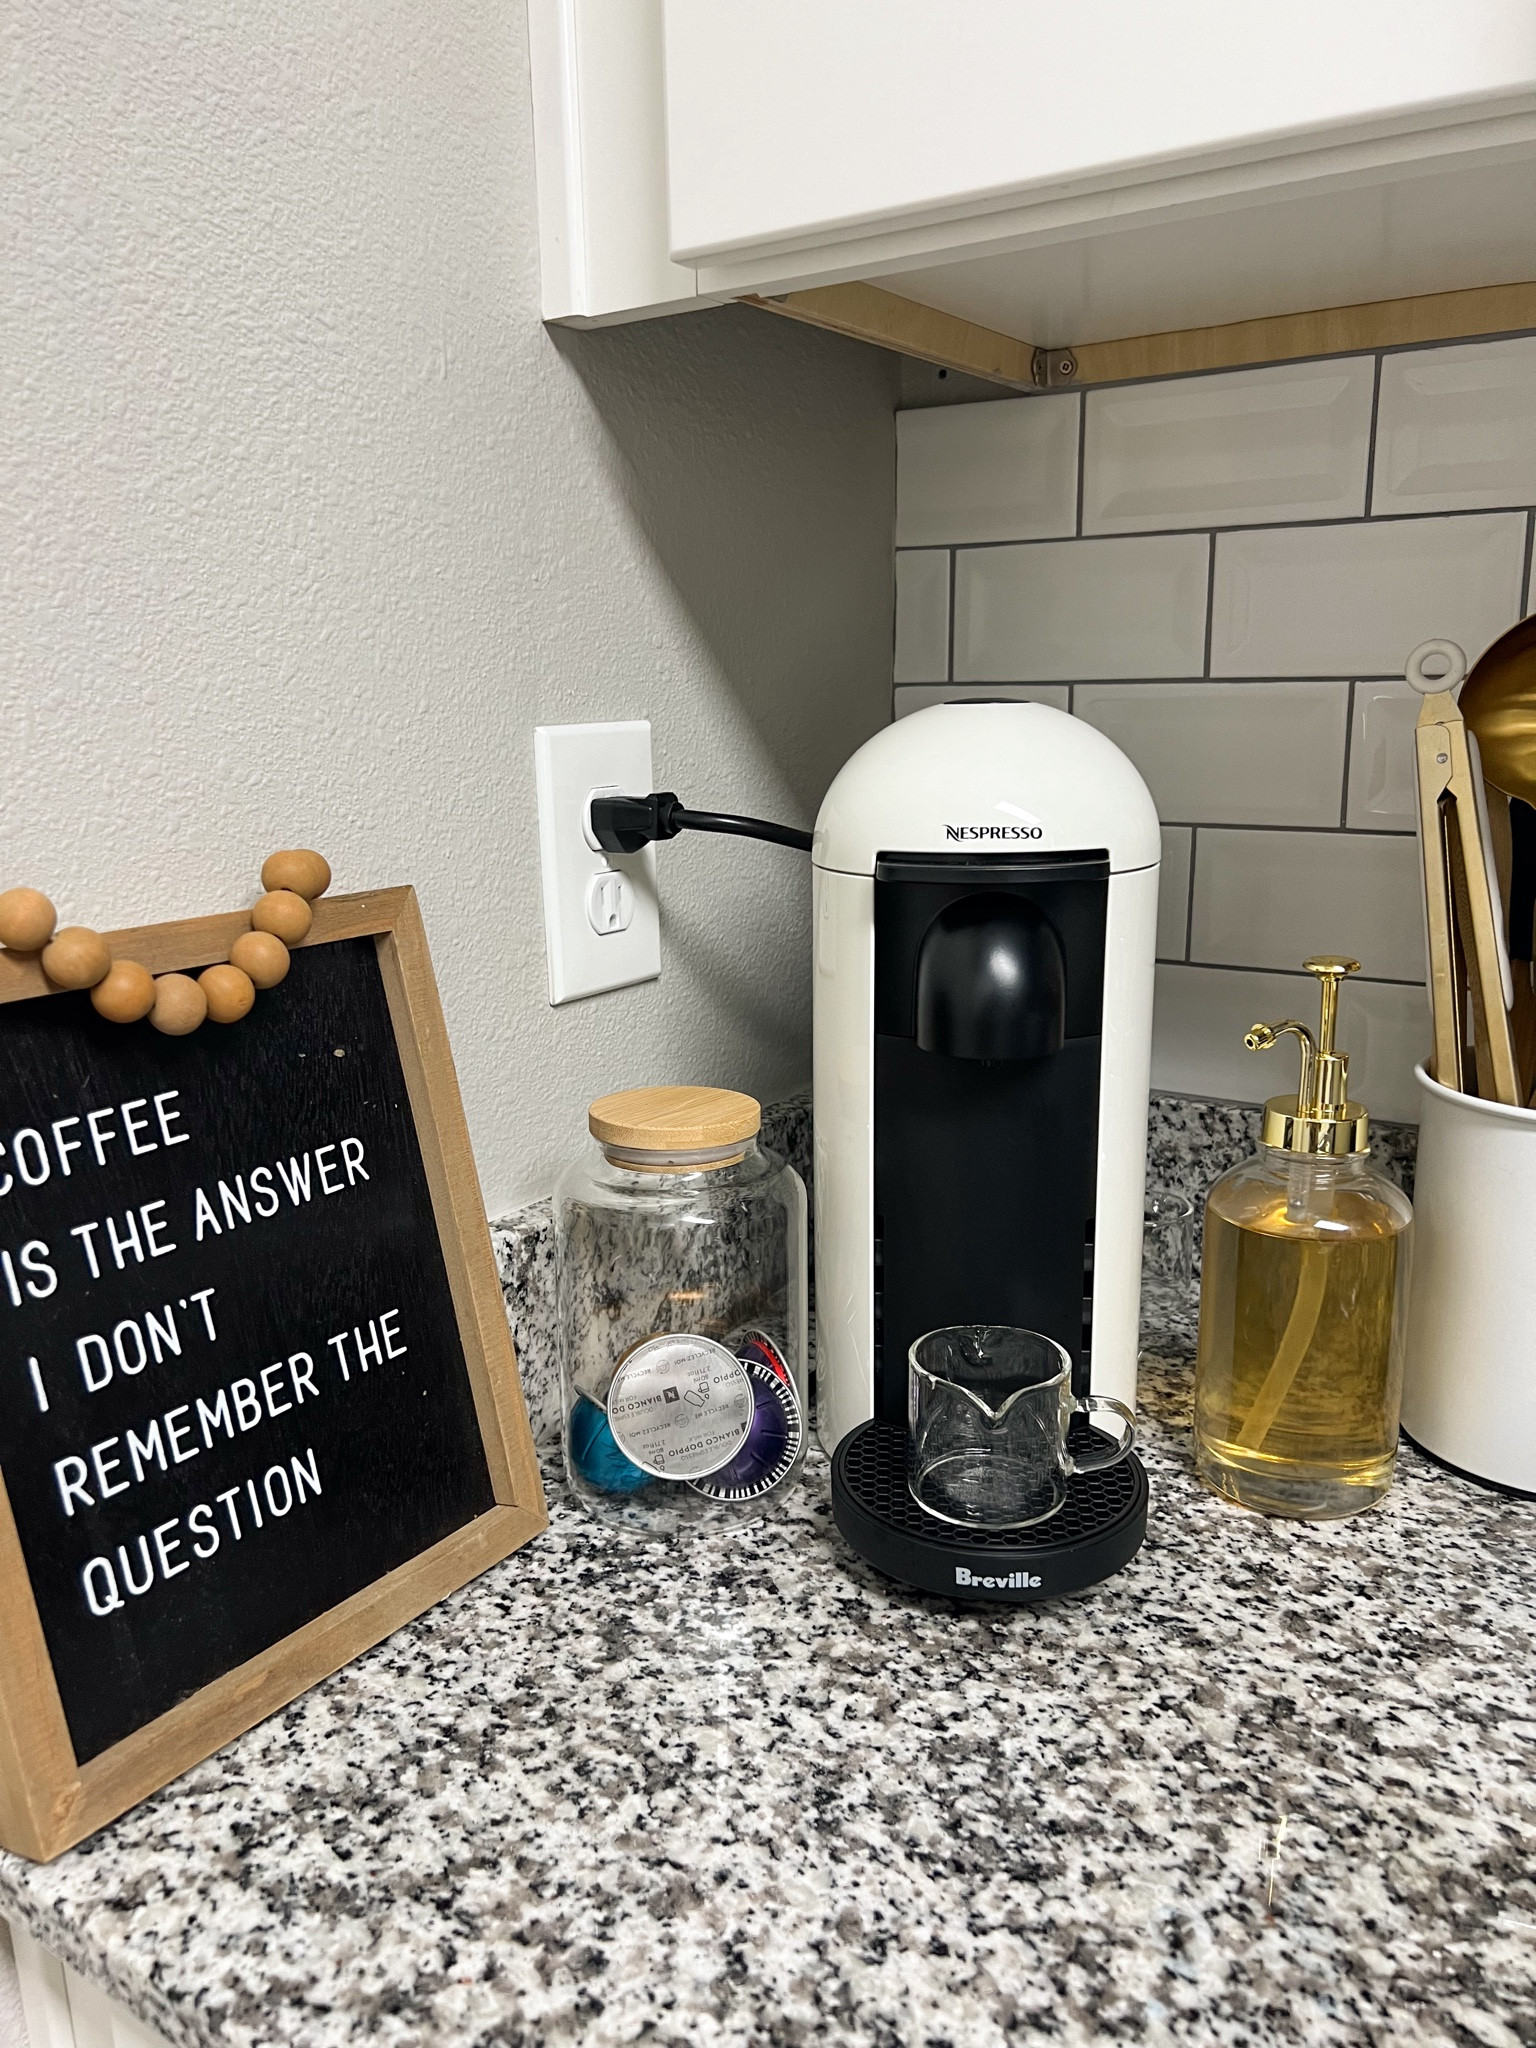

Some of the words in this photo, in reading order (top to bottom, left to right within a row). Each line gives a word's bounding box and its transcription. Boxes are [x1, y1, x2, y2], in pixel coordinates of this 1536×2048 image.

[941, 824, 1043, 842] NESPRESSO
[0, 1240, 58, 1306] IS
[70, 1200, 177, 1279] THE
[195, 1137, 370, 1242] ANSWER
[27, 1356, 49, 1413] I
[75, 1287, 217, 1393] DON'T
[54, 1351, 320, 1517] REMEMBER
[327, 1308, 408, 1382] THE
[627, 1395, 662, 1411] BIANCO
[705, 1428, 740, 1446] BIANCO
[668, 1441, 704, 1457] DOPPIO
[82, 1448, 323, 1616] QUESTION
[956, 1567, 1042, 1589] Breville
